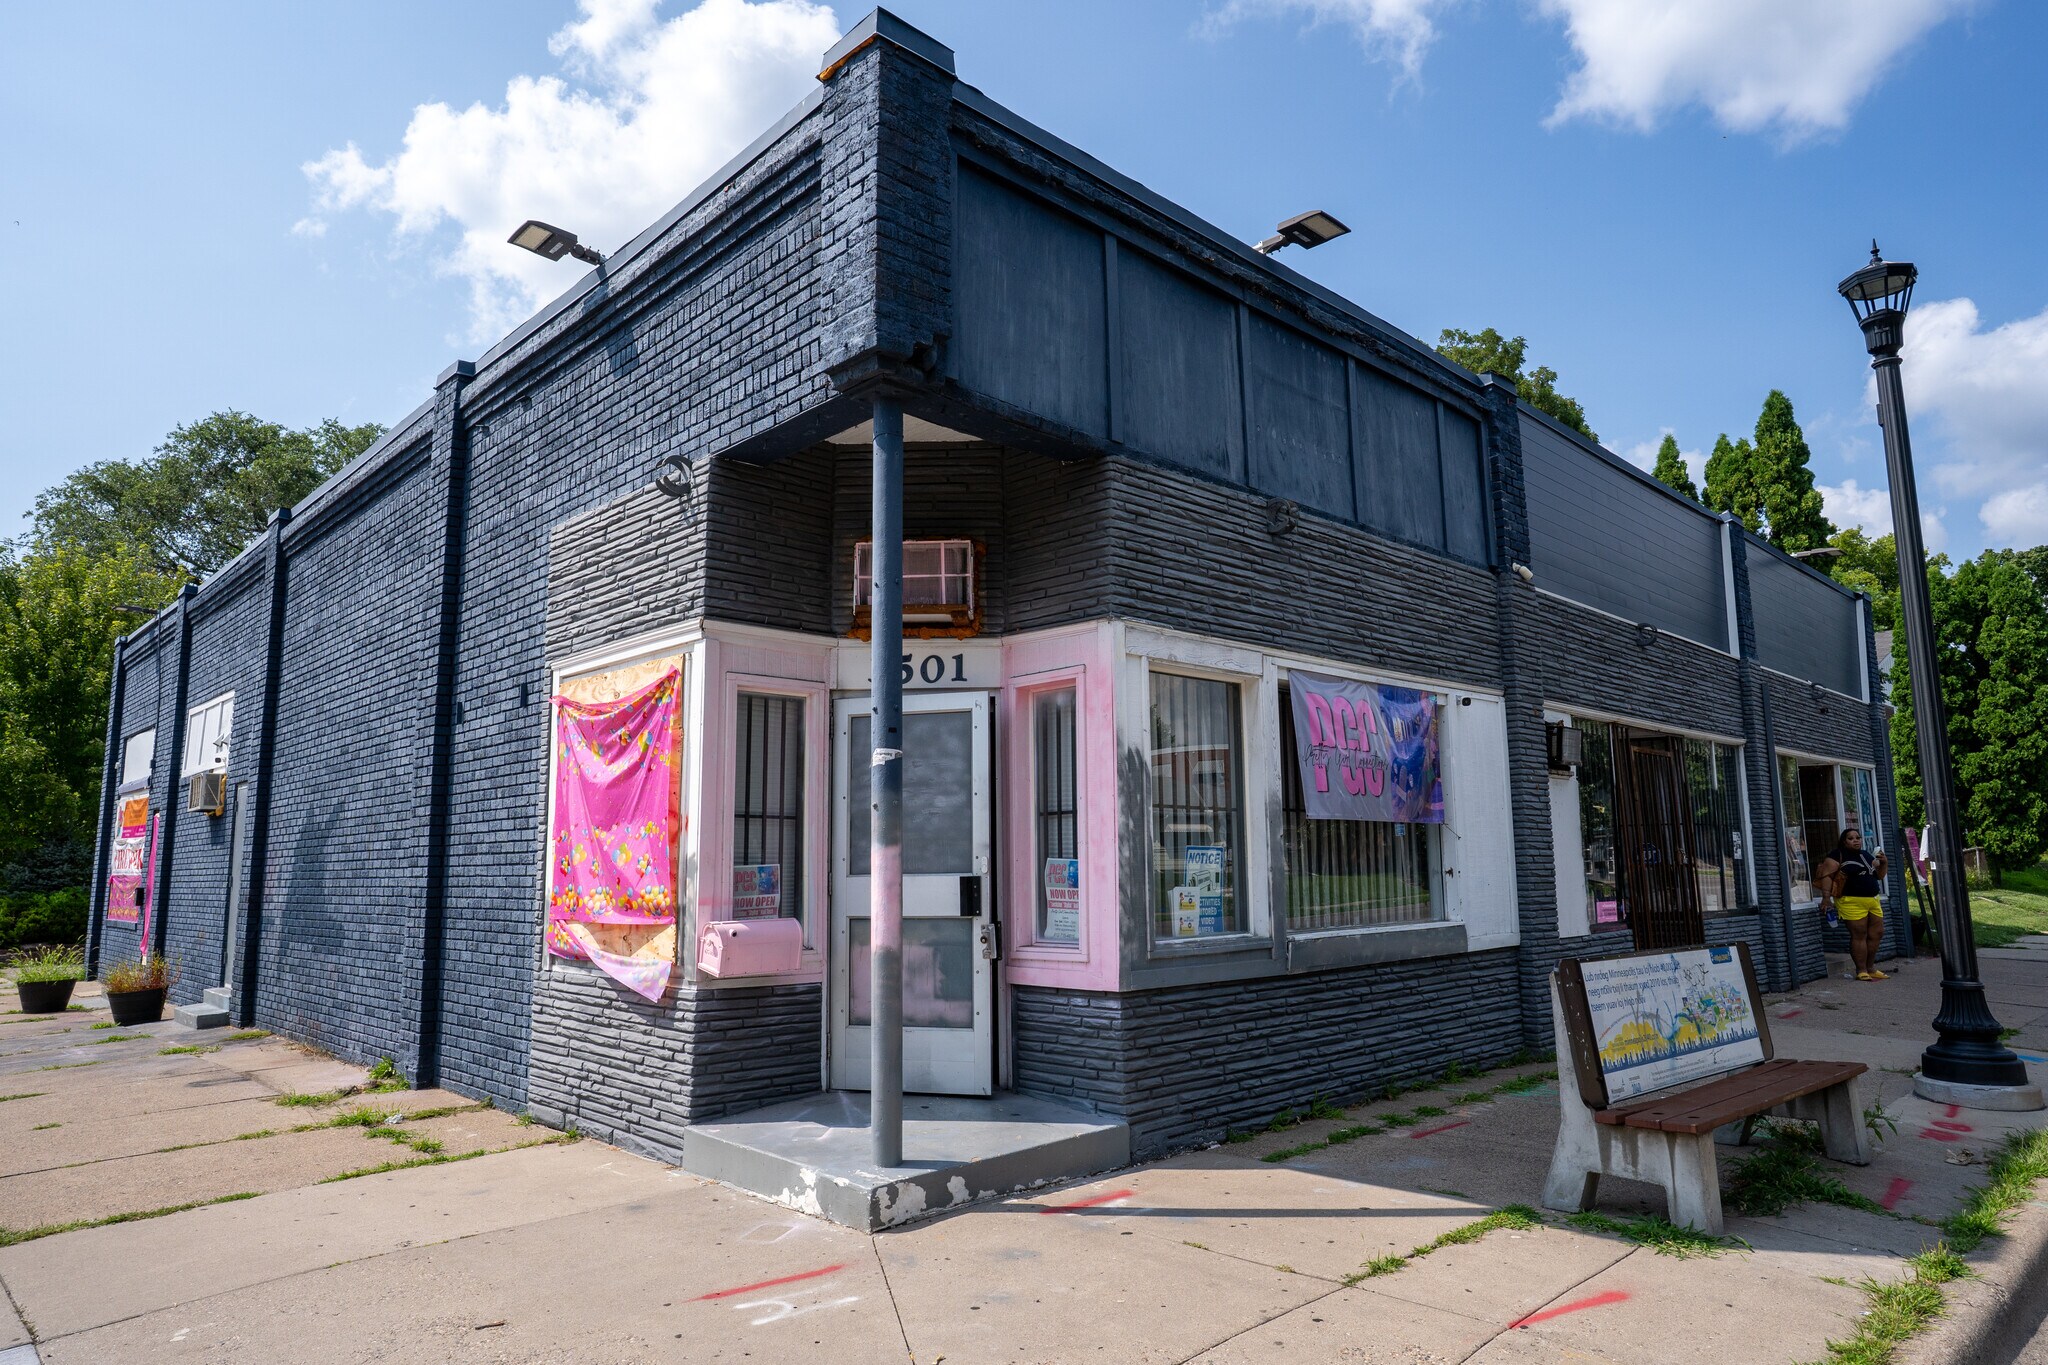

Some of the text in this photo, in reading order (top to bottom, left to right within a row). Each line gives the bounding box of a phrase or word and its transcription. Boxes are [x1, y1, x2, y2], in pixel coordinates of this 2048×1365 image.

[868, 653, 968, 685] 501
[1305, 691, 1385, 797] PGC
[1187, 851, 1221, 865] NOTICE
[1049, 888, 1079, 900] NOW OP
[735, 895, 776, 909] NOW OPEN
[1199, 898, 1221, 907] CTIVITIES
[1199, 907, 1217, 915] ITORED
[1201, 917, 1215, 925] VIDEO
[1609, 967, 1636, 979] Minneapolis
